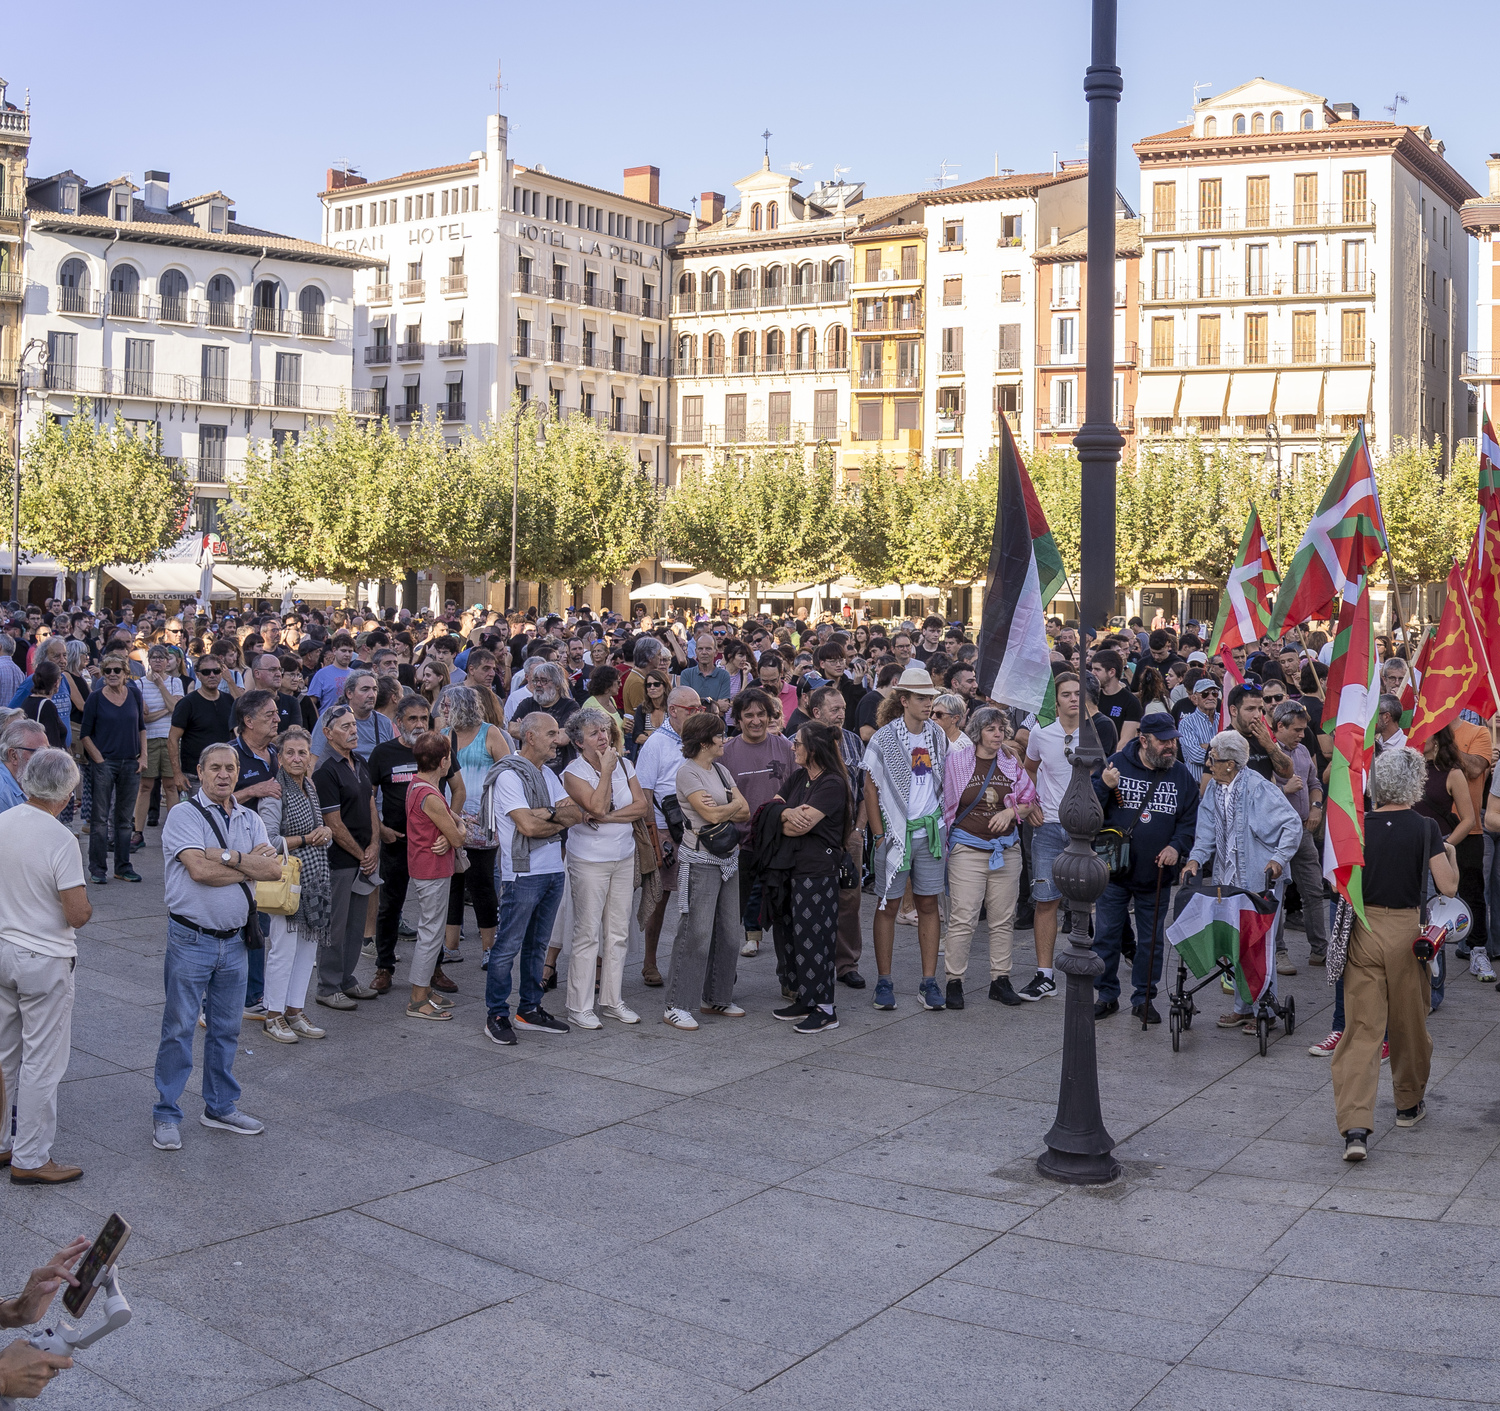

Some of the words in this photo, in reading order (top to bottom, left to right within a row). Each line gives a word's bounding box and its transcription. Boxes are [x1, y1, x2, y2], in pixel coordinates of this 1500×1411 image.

[334, 234, 384, 253] GRAN
[408, 222, 472, 245] HOTEL
[515, 220, 571, 250] HOTEL
[579, 236, 602, 257] LA
[609, 244, 661, 271] PERLA
